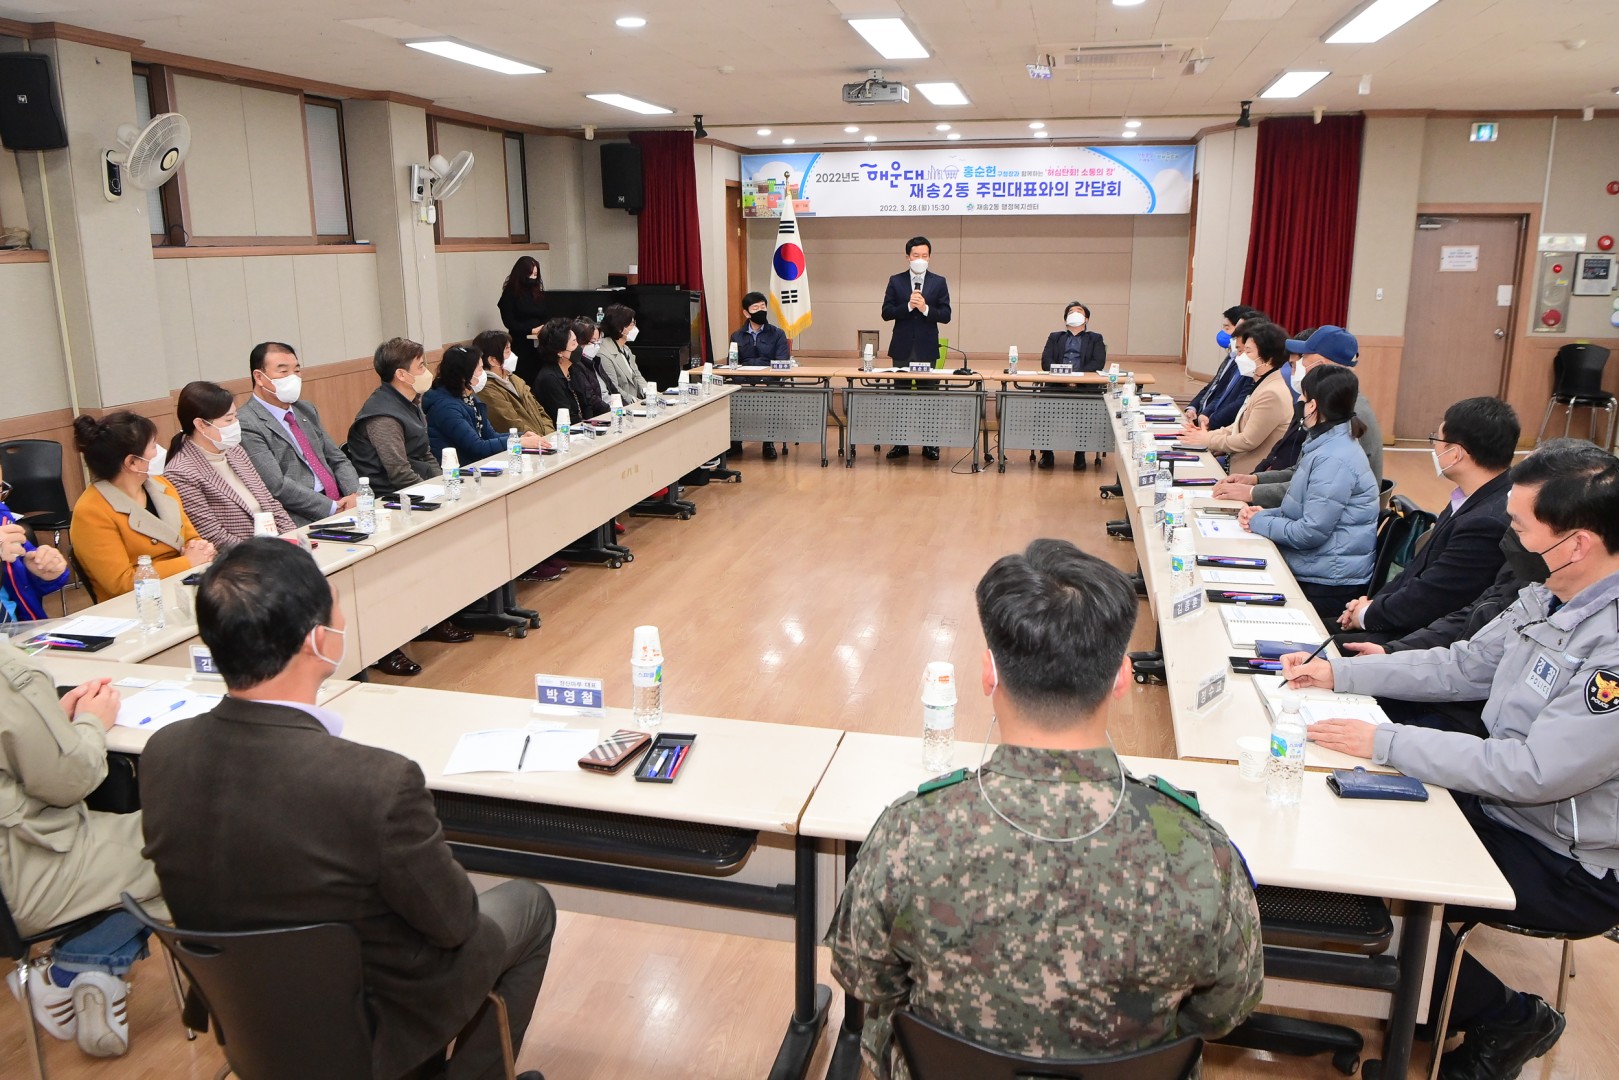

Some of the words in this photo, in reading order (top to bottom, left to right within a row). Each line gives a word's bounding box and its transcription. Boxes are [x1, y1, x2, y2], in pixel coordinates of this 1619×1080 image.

[815, 172, 860, 183] 2022년도
[860, 161, 924, 188] 해운대
[963, 165, 996, 178] 홍순헌
[1081, 167, 1104, 177] 소통의
[909, 181, 970, 199] 재송2동
[976, 181, 1069, 199] 주민대표와의
[1074, 180, 1122, 198] 간담회
[879, 204, 899, 212] 2022.
[931, 204, 950, 212] 15:30
[976, 203, 1000, 211] 재송2동
[1001, 203, 1039, 211] 행정복지센터
[1536, 658, 1555, 684] 경찰
[1530, 674, 1550, 696] POLICE
[1591, 697, 1610, 708] POLICE
